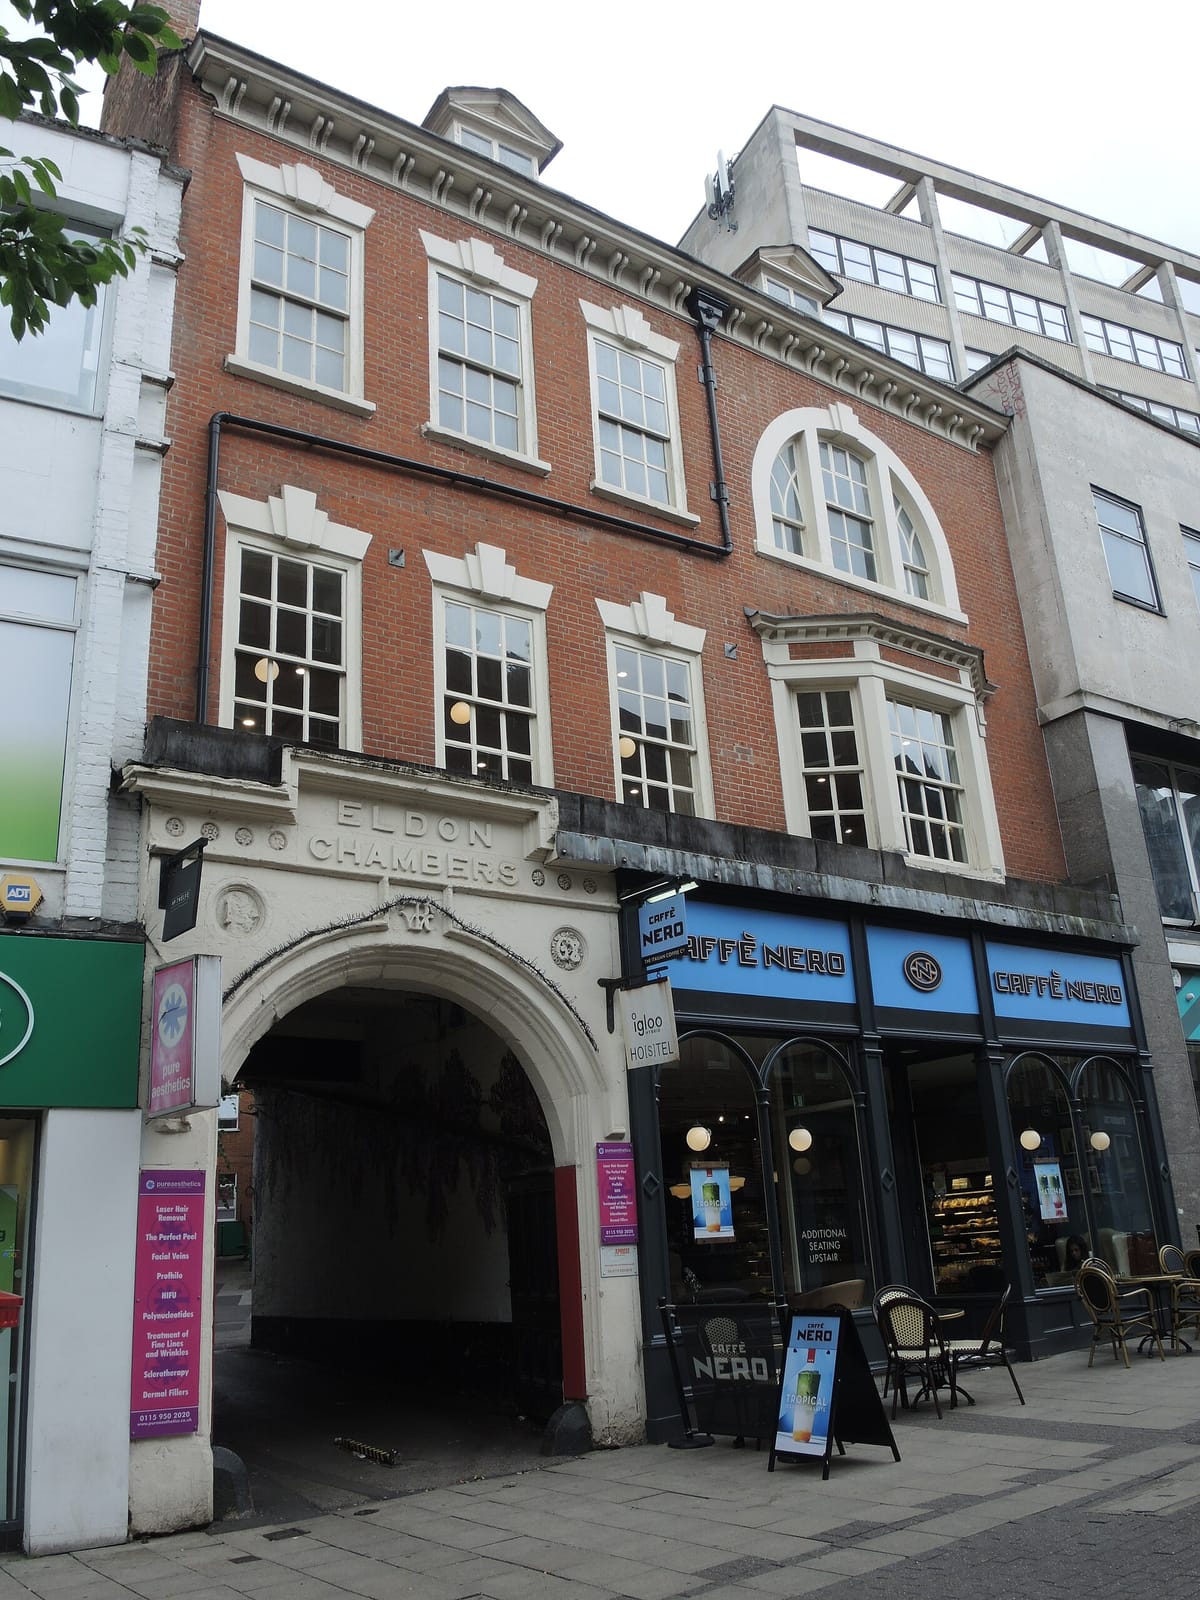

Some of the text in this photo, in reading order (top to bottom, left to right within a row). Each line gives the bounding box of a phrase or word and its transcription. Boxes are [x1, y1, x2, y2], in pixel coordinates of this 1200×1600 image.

[337, 799, 493, 848] ELDON
[309, 834, 520, 887] CHAMBERS
[7, 887, 32, 899] ADT
[648, 906, 676, 925] CAFFÈ
[642, 921, 684, 947] NERO
[686, 931, 847, 976] AFFÈ NERO
[994, 968, 1123, 1004] CAFFÈ NERO
[631, 1012, 663, 1037] igloo
[162, 1061, 180, 1081] pure
[151, 1076, 191, 1099] aesthetics
[156, 1180, 201, 1189] pureaesthetics
[156, 1205, 189, 1213] Laser Hair
[158, 1214, 186, 1222] Removal
[145, 1232, 197, 1241] The Perfect Peel
[801, 1228, 847, 1239] ADDITIONAL
[808, 1240, 841, 1251] SEATING
[151, 1252, 189, 1261] Facial Veins
[156, 1271, 183, 1280] Profhilo
[161, 1291, 177, 1299] HIFU
[142, 1310, 194, 1320] Polynucleotides
[146, 1330, 189, 1340] Treatment of
[797, 1330, 833, 1342] NERO
[151, 1340, 184, 1349] Fine Lines
[711, 1341, 746, 1353] CAFFÈ
[145, 1348, 189, 1358] and Wrinkles
[143, 1368, 189, 1379] Sclerotherapy
[692, 1356, 769, 1381] NERO
[142, 1388, 189, 1399] Dermal Fillers
[786, 1393, 827, 1406] TROPICAL
[139, 1411, 191, 1422] 0115 950 2020
